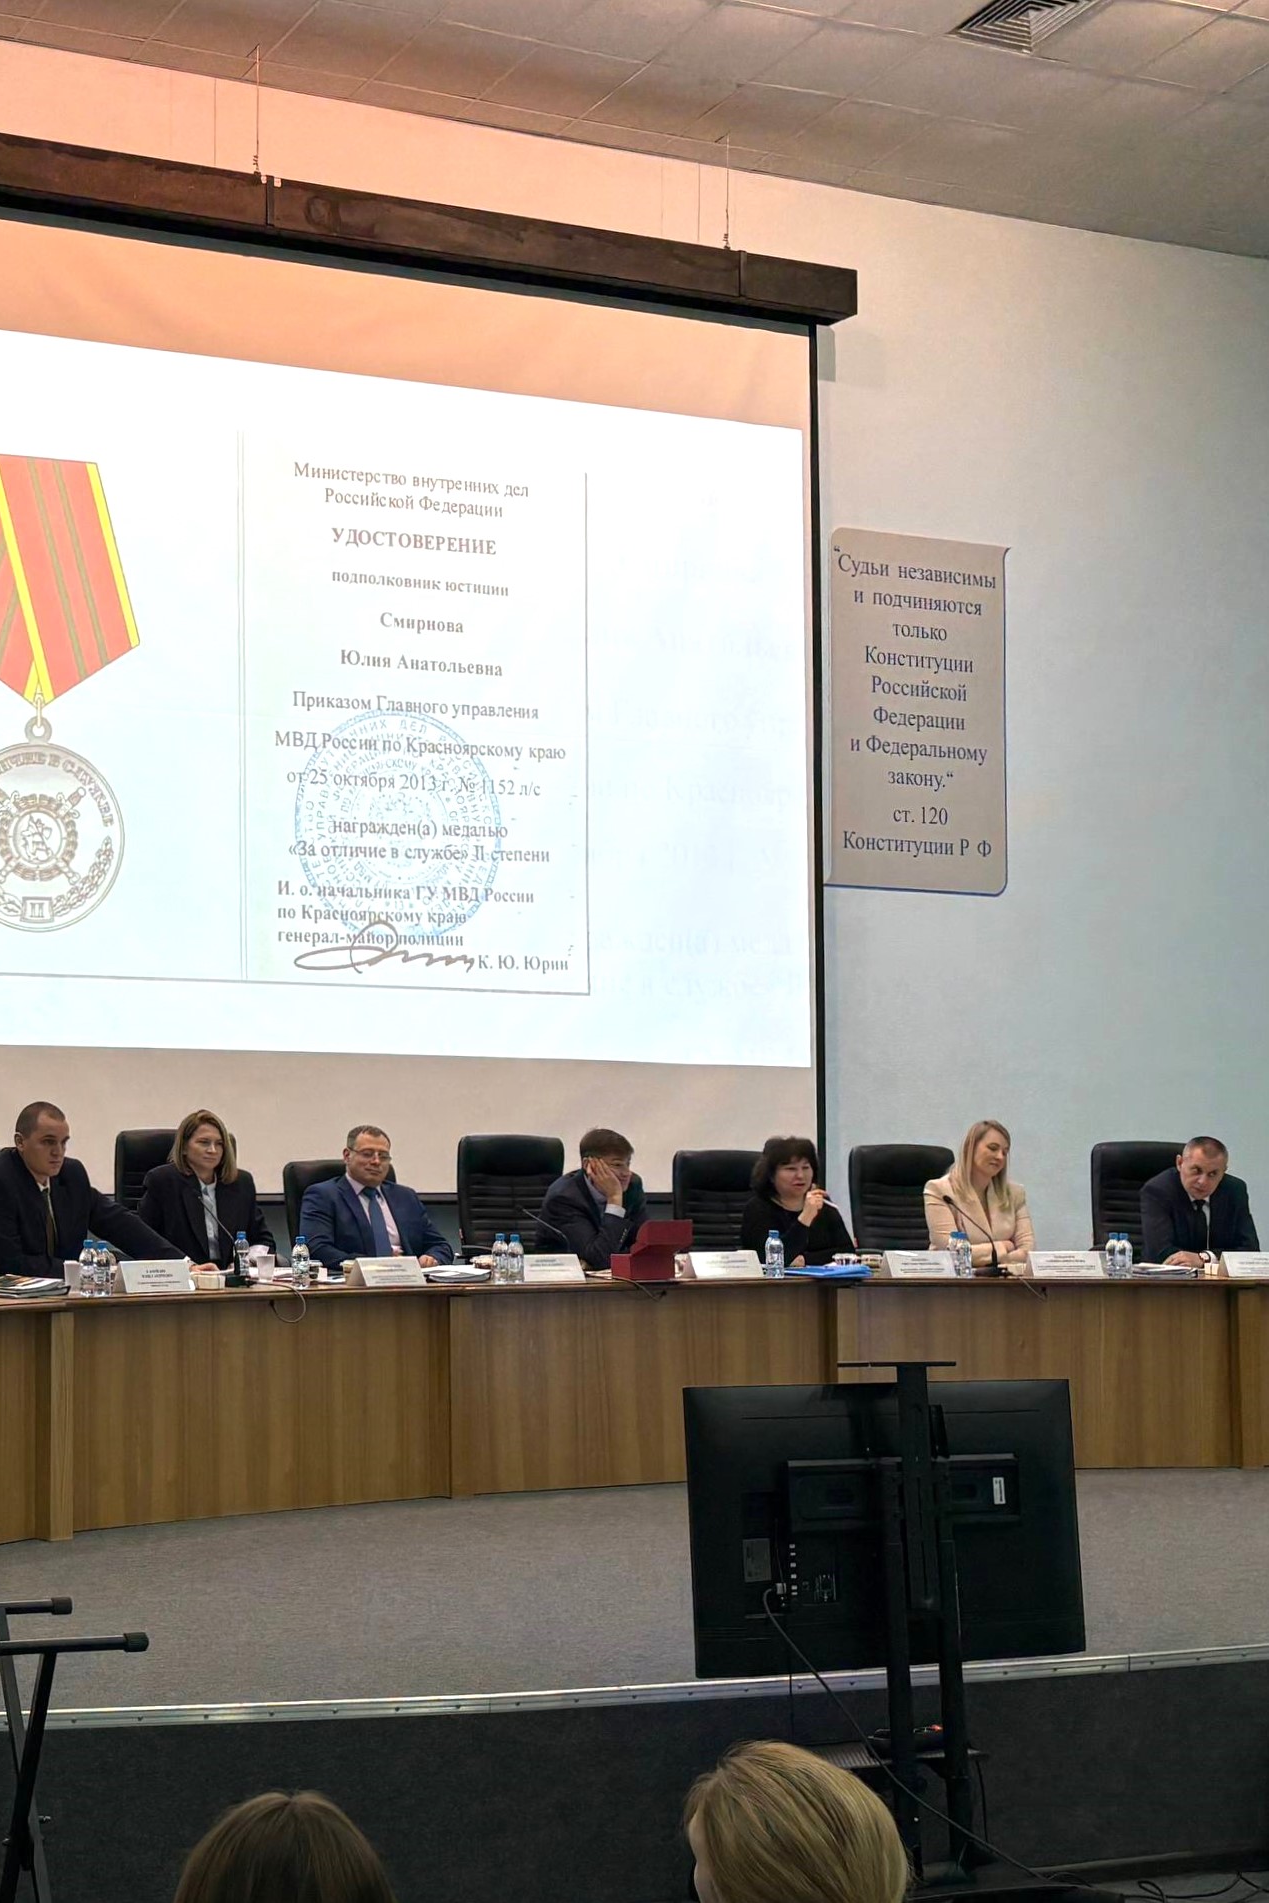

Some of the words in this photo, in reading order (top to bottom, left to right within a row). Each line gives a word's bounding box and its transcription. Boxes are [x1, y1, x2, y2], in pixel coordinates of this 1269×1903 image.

[294, 462, 407, 486] Министерство
[412, 475, 500, 495] внутренних
[504, 483, 529, 498] дел
[325, 488, 414, 510] Российской
[419, 496, 503, 518] Федерации
[331, 527, 497, 556] УДОСТОВЕРЕНИЕ
[332, 571, 441, 591] подполковник
[445, 580, 509, 597] юстиции
[898, 564, 996, 589] независимы
[854, 590, 863, 603] и
[872, 592, 982, 616] подчиняются
[380, 612, 464, 634] Смирнова
[893, 623, 948, 641] только
[340, 649, 391, 669] Юлия
[397, 654, 503, 677] Анатольевна
[865, 646, 973, 674] Конституции
[871, 675, 967, 701] Российской
[293, 691, 371, 712] Приказом
[376, 695, 448, 715] Главного
[452, 703, 539, 720] управления
[873, 706, 965, 732] Федерации
[275, 731, 321, 753] МВД
[321, 733, 378, 751] России
[382, 740, 402, 753] по
[406, 737, 523, 761] Красноярскому
[529, 747, 566, 760] краю
[850, 738, 860, 751] и
[866, 735, 987, 766] Федеральному
[287, 772, 303, 783] от
[309, 769, 328, 785] 25
[333, 770, 395, 790] октября
[399, 774, 437, 792] 2013
[519, 783, 541, 796] л/с
[893, 808, 915, 824] ст.
[921, 805, 948, 825] 120
[332, 819, 437, 840] награжден(а)
[442, 825, 508, 839] медалью
[289, 841, 317, 858] «За
[321, 846, 387, 859] отличие
[391, 847, 399, 858] в
[404, 844, 469, 864] службе»
[491, 850, 550, 863] степени
[843, 831, 954, 858] Конституции
[959, 838, 969, 856] Р
[977, 840, 992, 857] Ф
[278, 880, 294, 896] И.
[317, 884, 411, 901] начальника
[443, 887, 479, 905] МВД
[485, 888, 534, 903] России
[278, 908, 296, 919] по
[301, 904, 423, 924] Красноярскому
[428, 913, 467, 926] краю
[399, 933, 463, 947] полиции
[478, 954, 493, 970] К.
[498, 955, 519, 971] Ю.
[524, 955, 569, 974] Юрин
